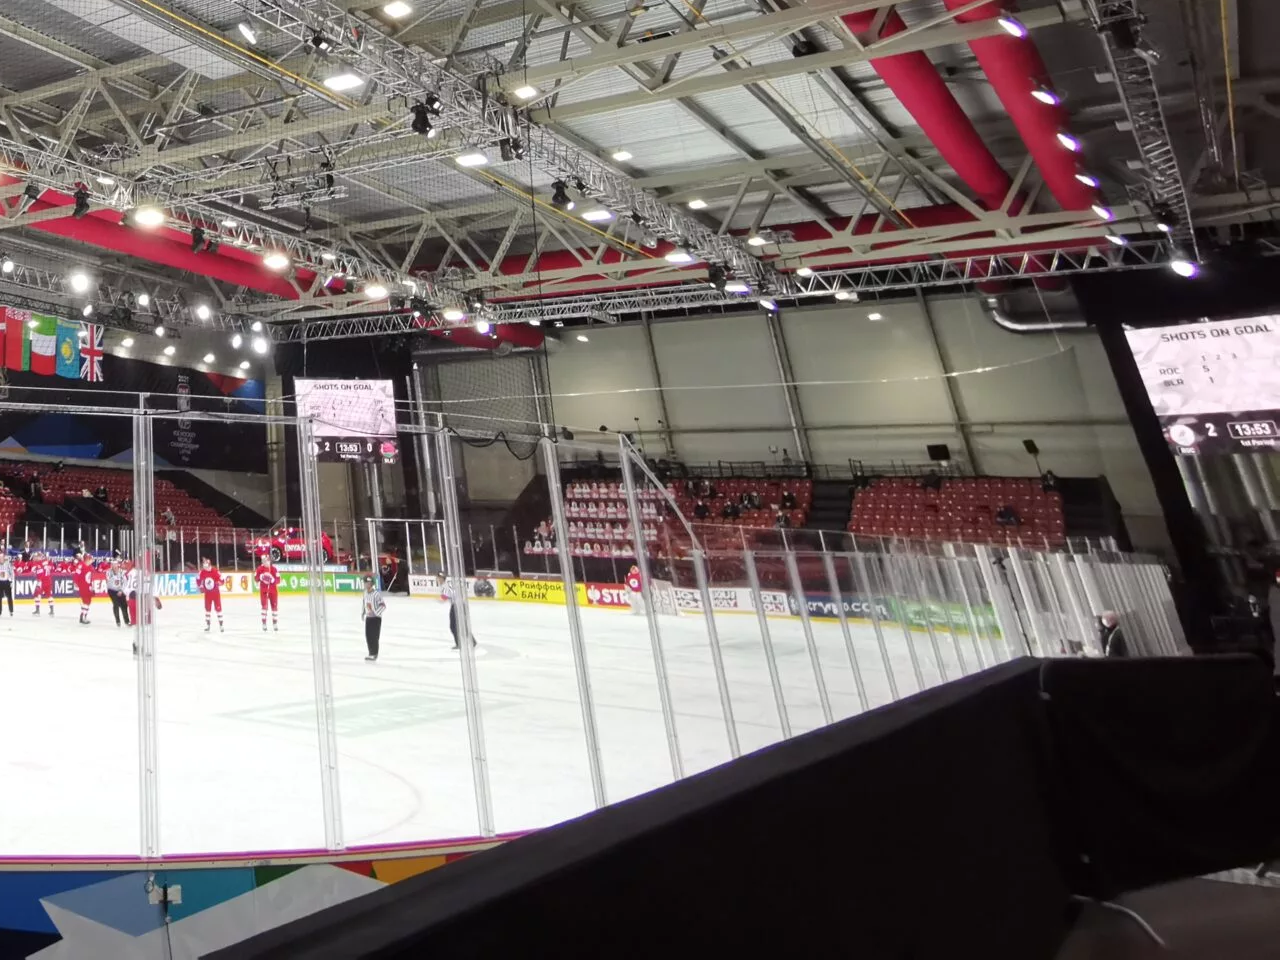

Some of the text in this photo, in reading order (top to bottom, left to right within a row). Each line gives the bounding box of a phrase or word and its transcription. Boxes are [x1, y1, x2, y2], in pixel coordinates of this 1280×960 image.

[1161, 325, 1272, 343] SHOTS ON GOAL
[1160, 367, 1181, 375] ROC
[1205, 423, 1271, 437] 2 13:53
[325, 442, 373, 452] 2 13:53 0
[16, 581, 37, 594] NIV
[55, 581, 74, 593] ME
[154, 573, 187, 596] Wolt
[521, 591, 548, 601] БАНК
[602, 588, 629, 604] STR
[763, 603, 784, 613] OLY
